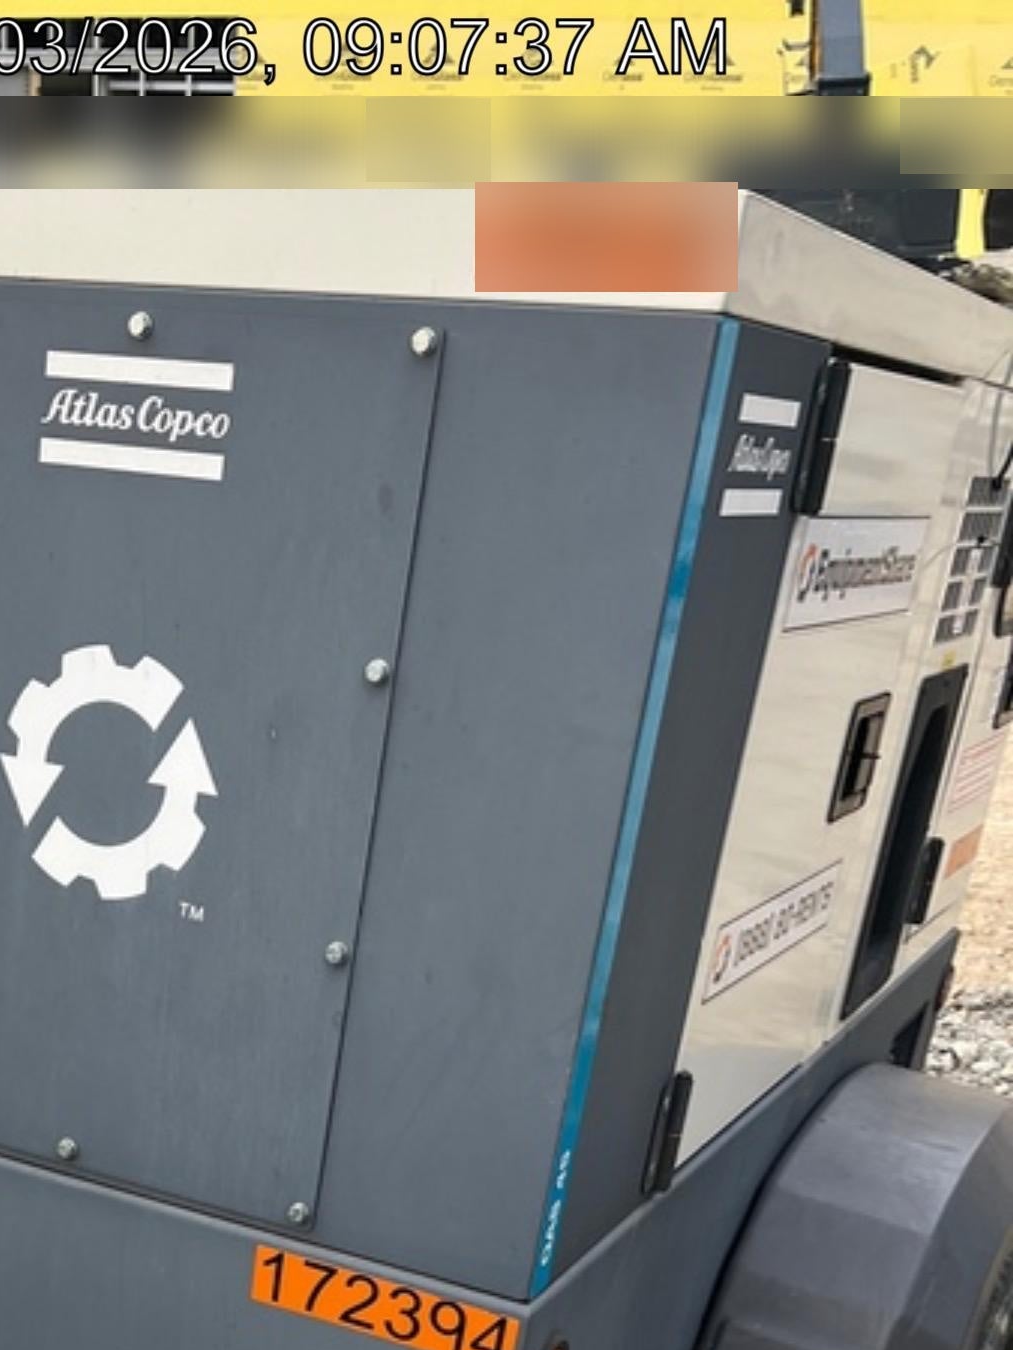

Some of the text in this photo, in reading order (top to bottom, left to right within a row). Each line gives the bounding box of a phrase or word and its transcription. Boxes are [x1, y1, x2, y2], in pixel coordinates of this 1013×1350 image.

[41, 388, 231, 443] Atlas Copco
[179, 902, 205, 921] TM
